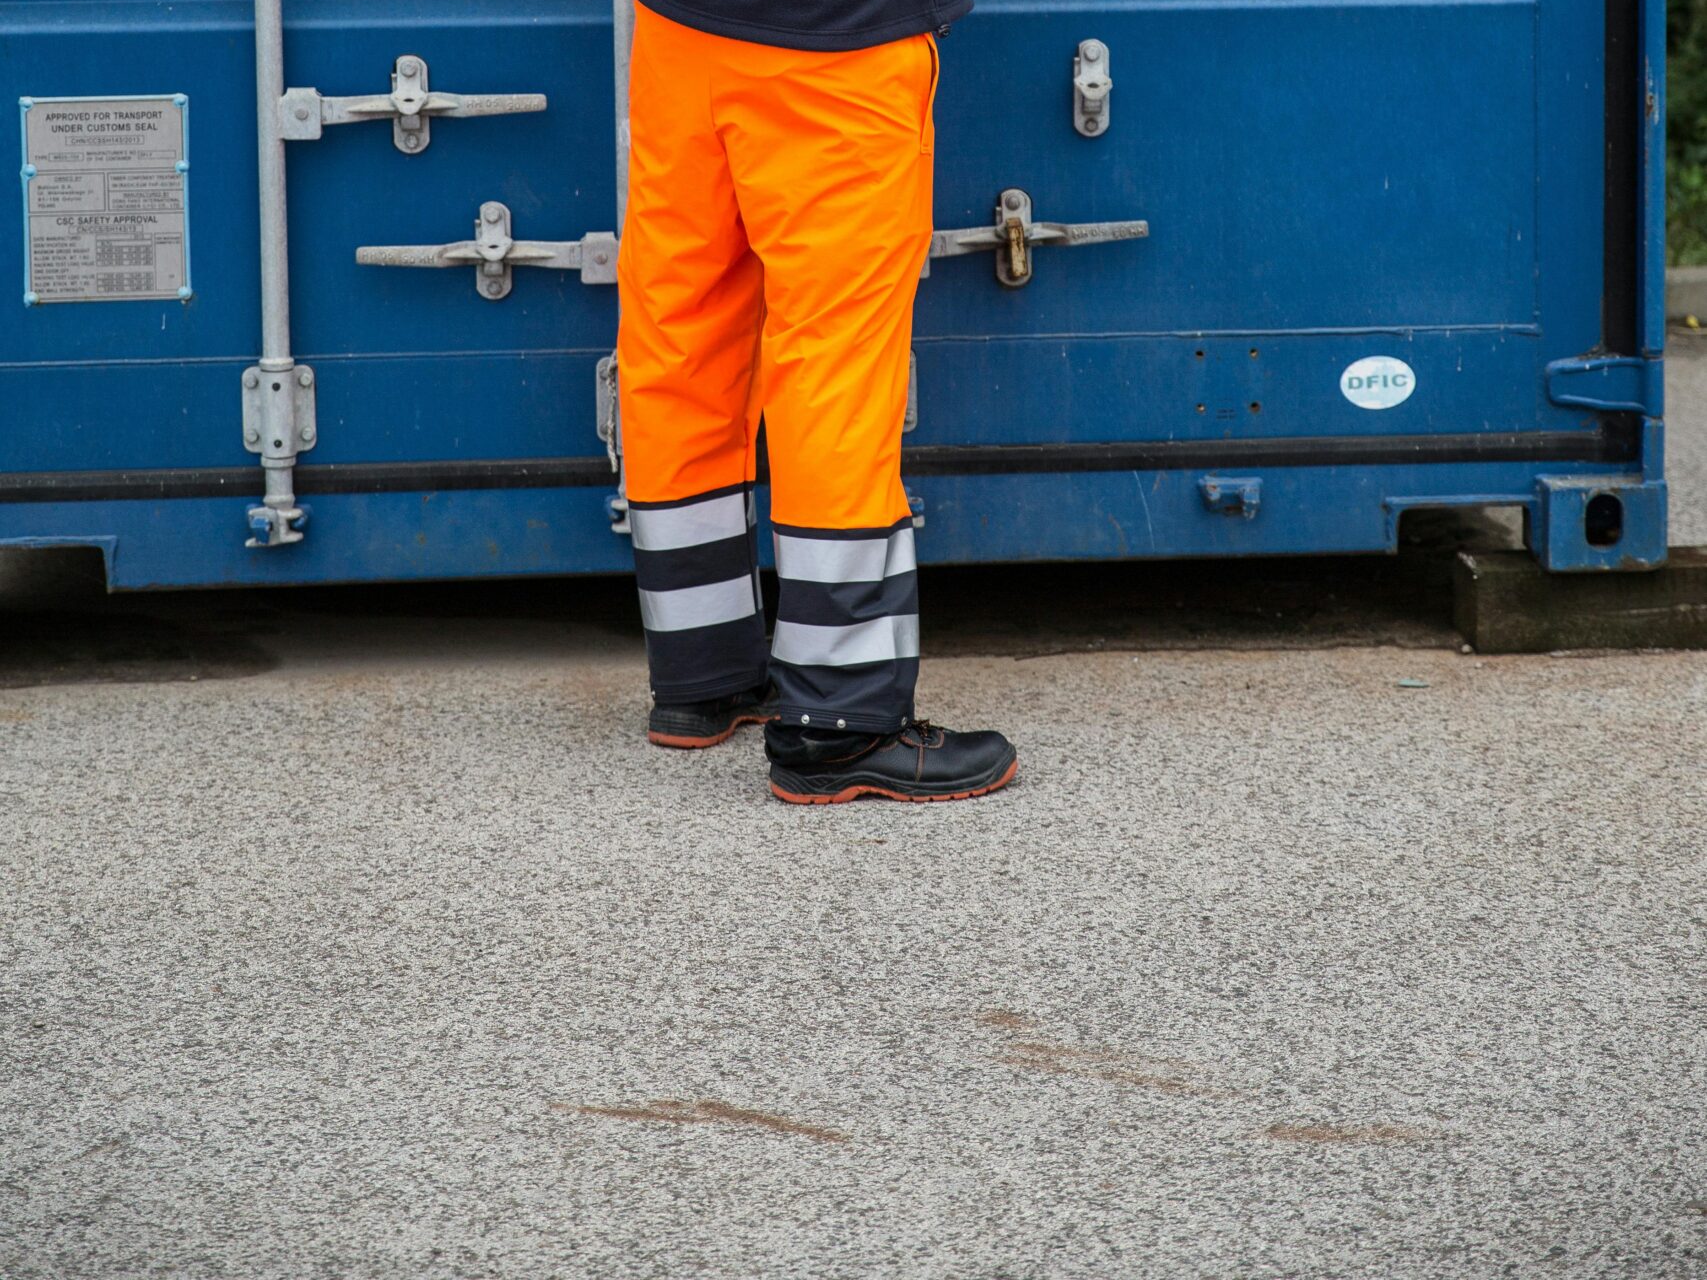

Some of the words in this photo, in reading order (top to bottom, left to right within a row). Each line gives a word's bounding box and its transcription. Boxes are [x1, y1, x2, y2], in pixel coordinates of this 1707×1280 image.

[46, 112, 90, 121] APPROVED
[94, 112, 110, 120] FOR
[114, 111, 162, 119] TRANSPORT
[51, 124, 83, 133] UNDER
[87, 123, 131, 132] CUSTOMS
[135, 122, 158, 131] SEAL
[56, 217, 74, 225] CSC
[77, 216, 110, 224] SAFETY
[113, 215, 158, 224] APPROVAL
[1348, 373, 1408, 389] DFIC
